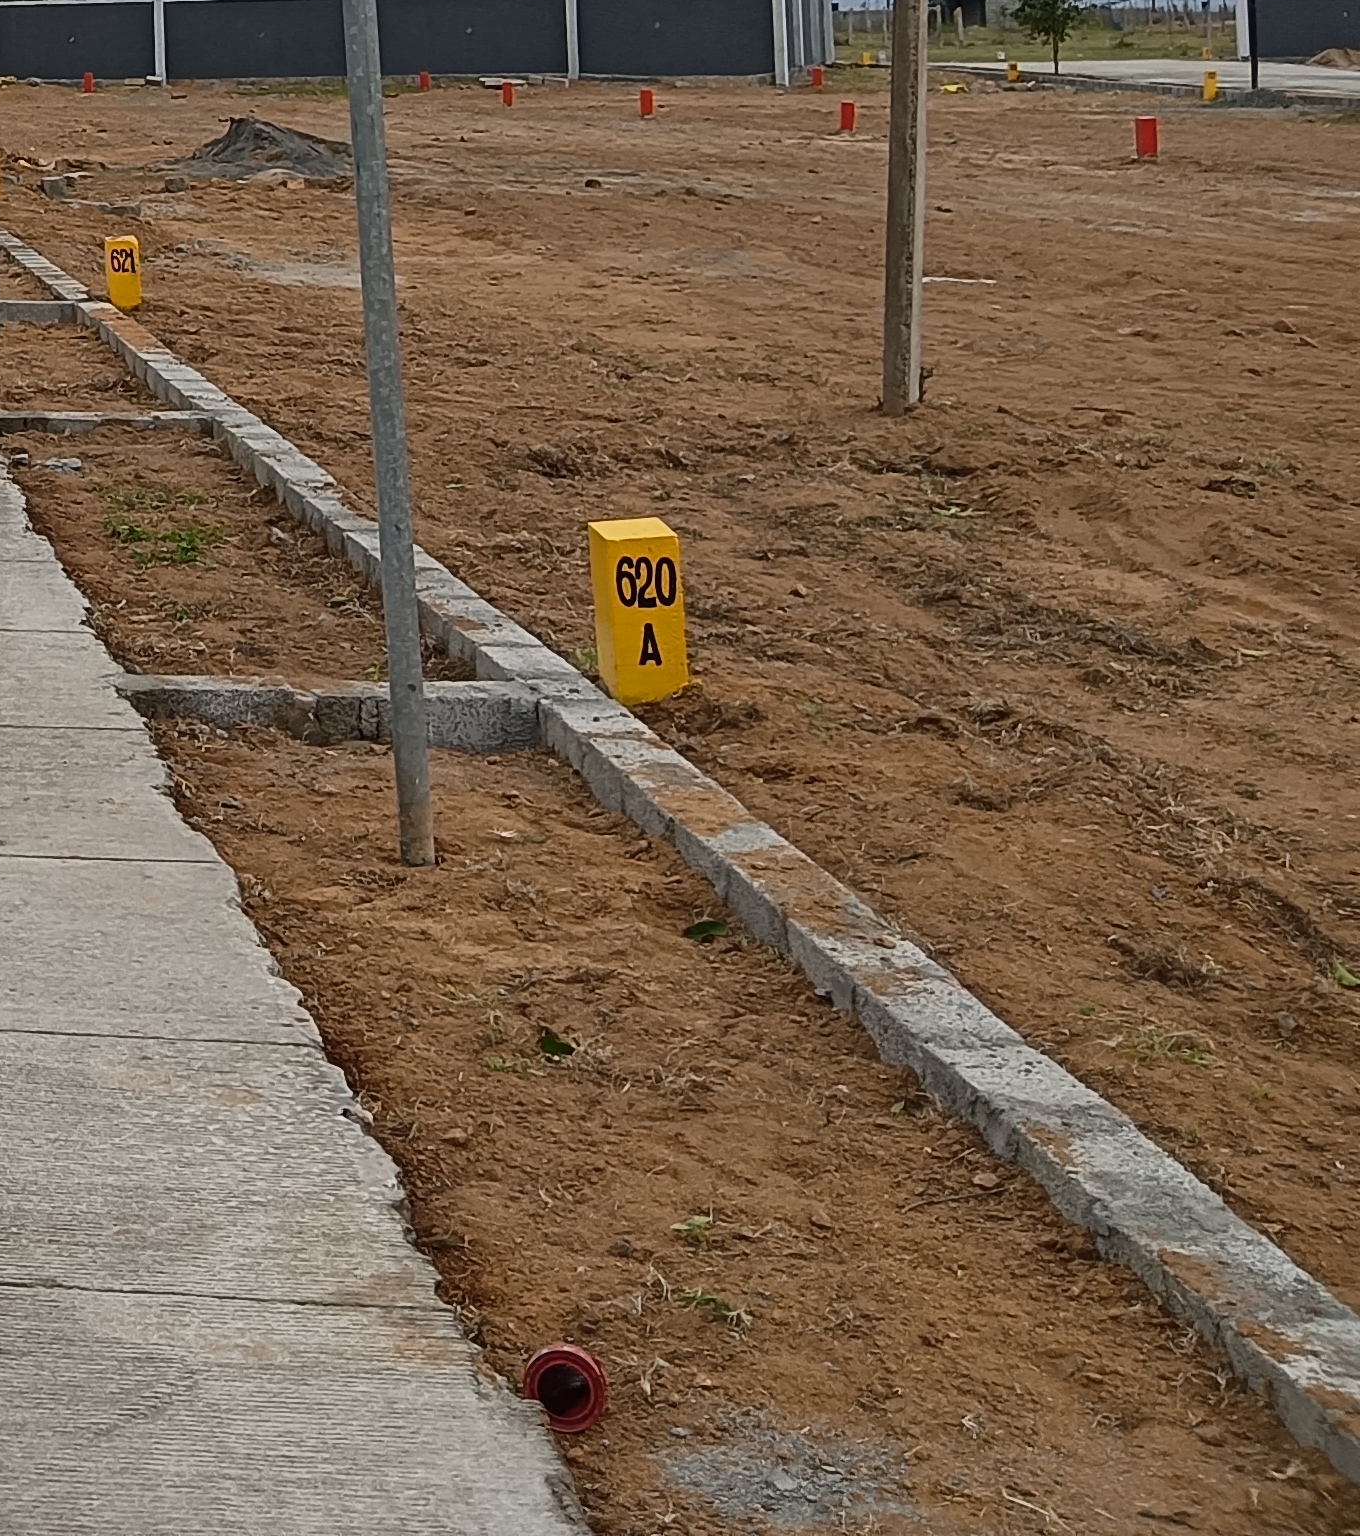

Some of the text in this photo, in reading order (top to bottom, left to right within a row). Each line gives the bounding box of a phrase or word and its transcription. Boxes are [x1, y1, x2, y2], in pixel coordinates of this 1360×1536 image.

[110, 248, 137, 274] 621
[615, 555, 677, 609] 620
[638, 622, 663, 667] A
